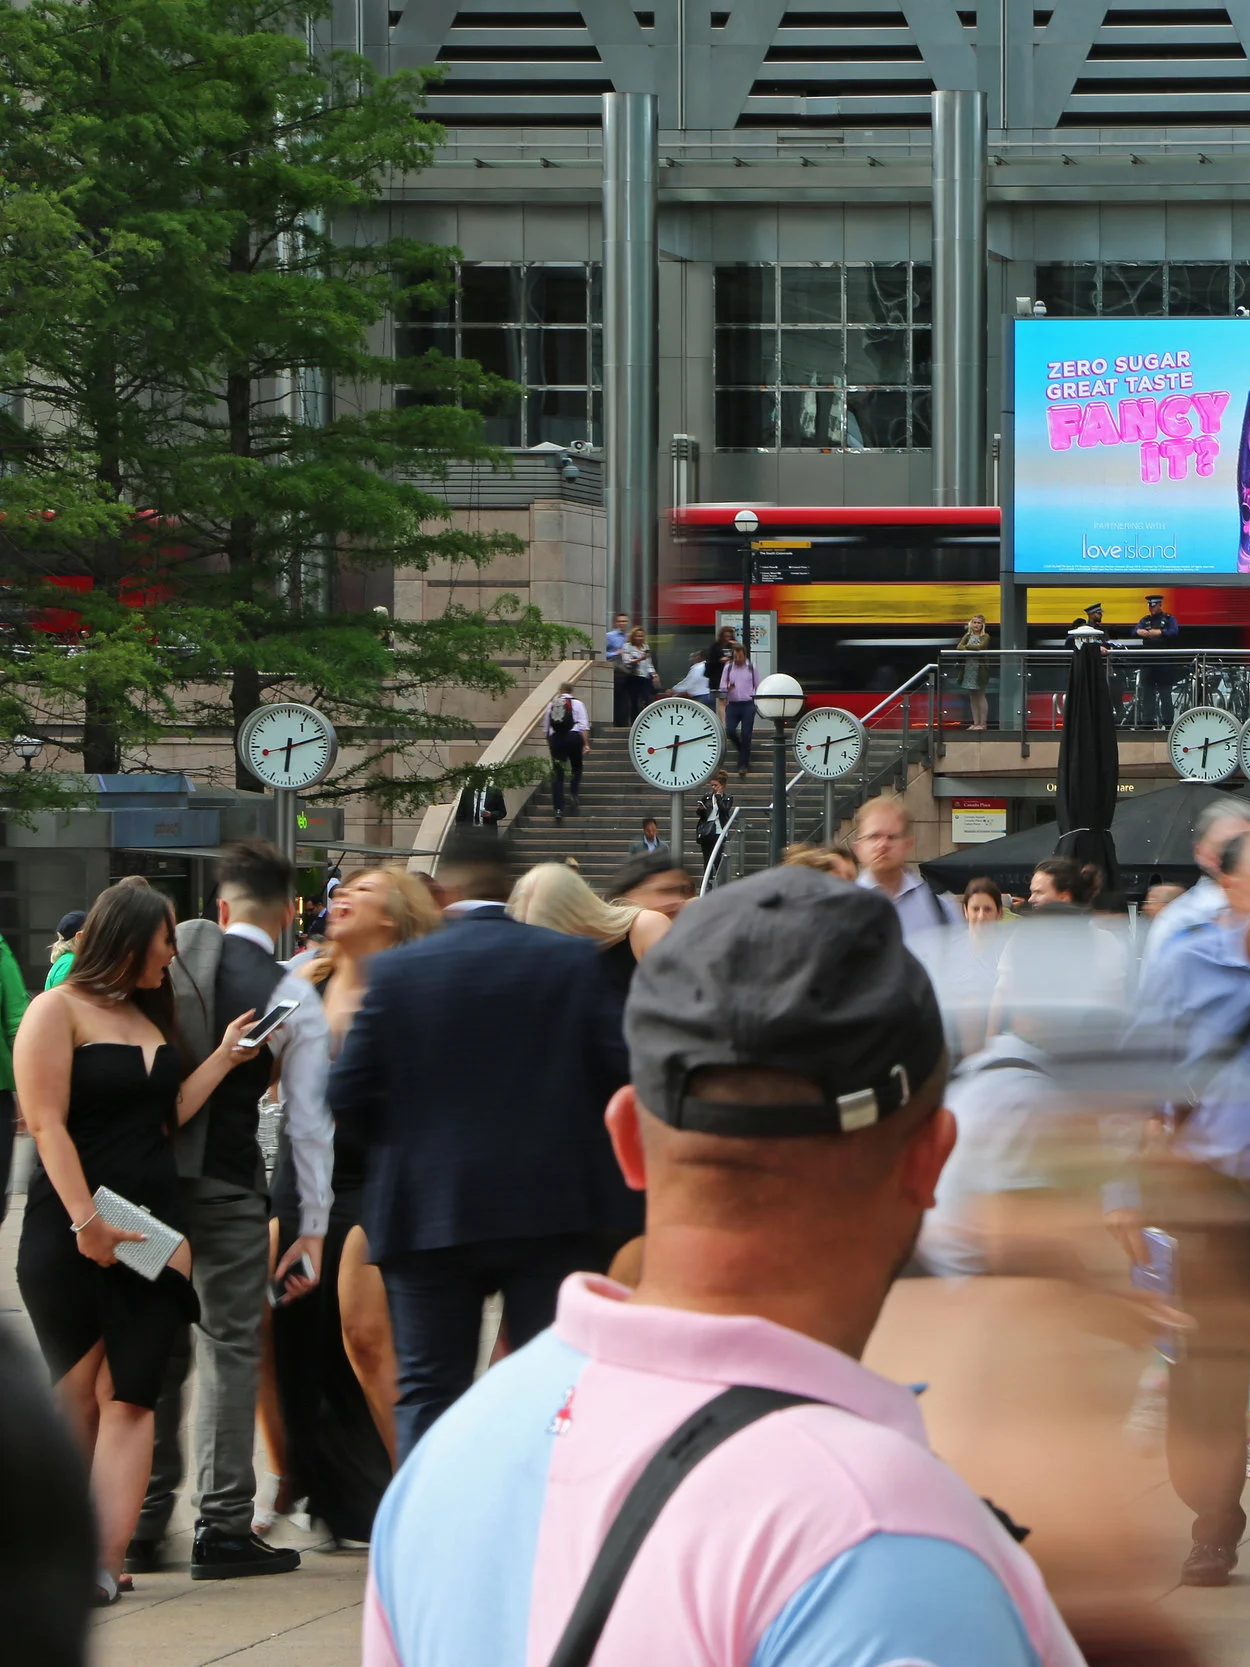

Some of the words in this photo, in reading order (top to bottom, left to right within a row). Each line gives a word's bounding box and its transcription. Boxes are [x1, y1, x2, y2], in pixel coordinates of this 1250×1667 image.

[1047, 358, 1108, 380] ZERO
[1114, 350, 1192, 373] SUGAR
[1046, 378, 1119, 401] GREAT
[1125, 371, 1194, 394] TASTE
[1046, 390, 1231, 451] FANCY
[1139, 434, 1220, 484] IT?
[1082, 533, 1122, 559] love
[1124, 533, 1177, 559] island
[669, 716, 684, 727] 12
[1225, 742, 1231, 750] 3
